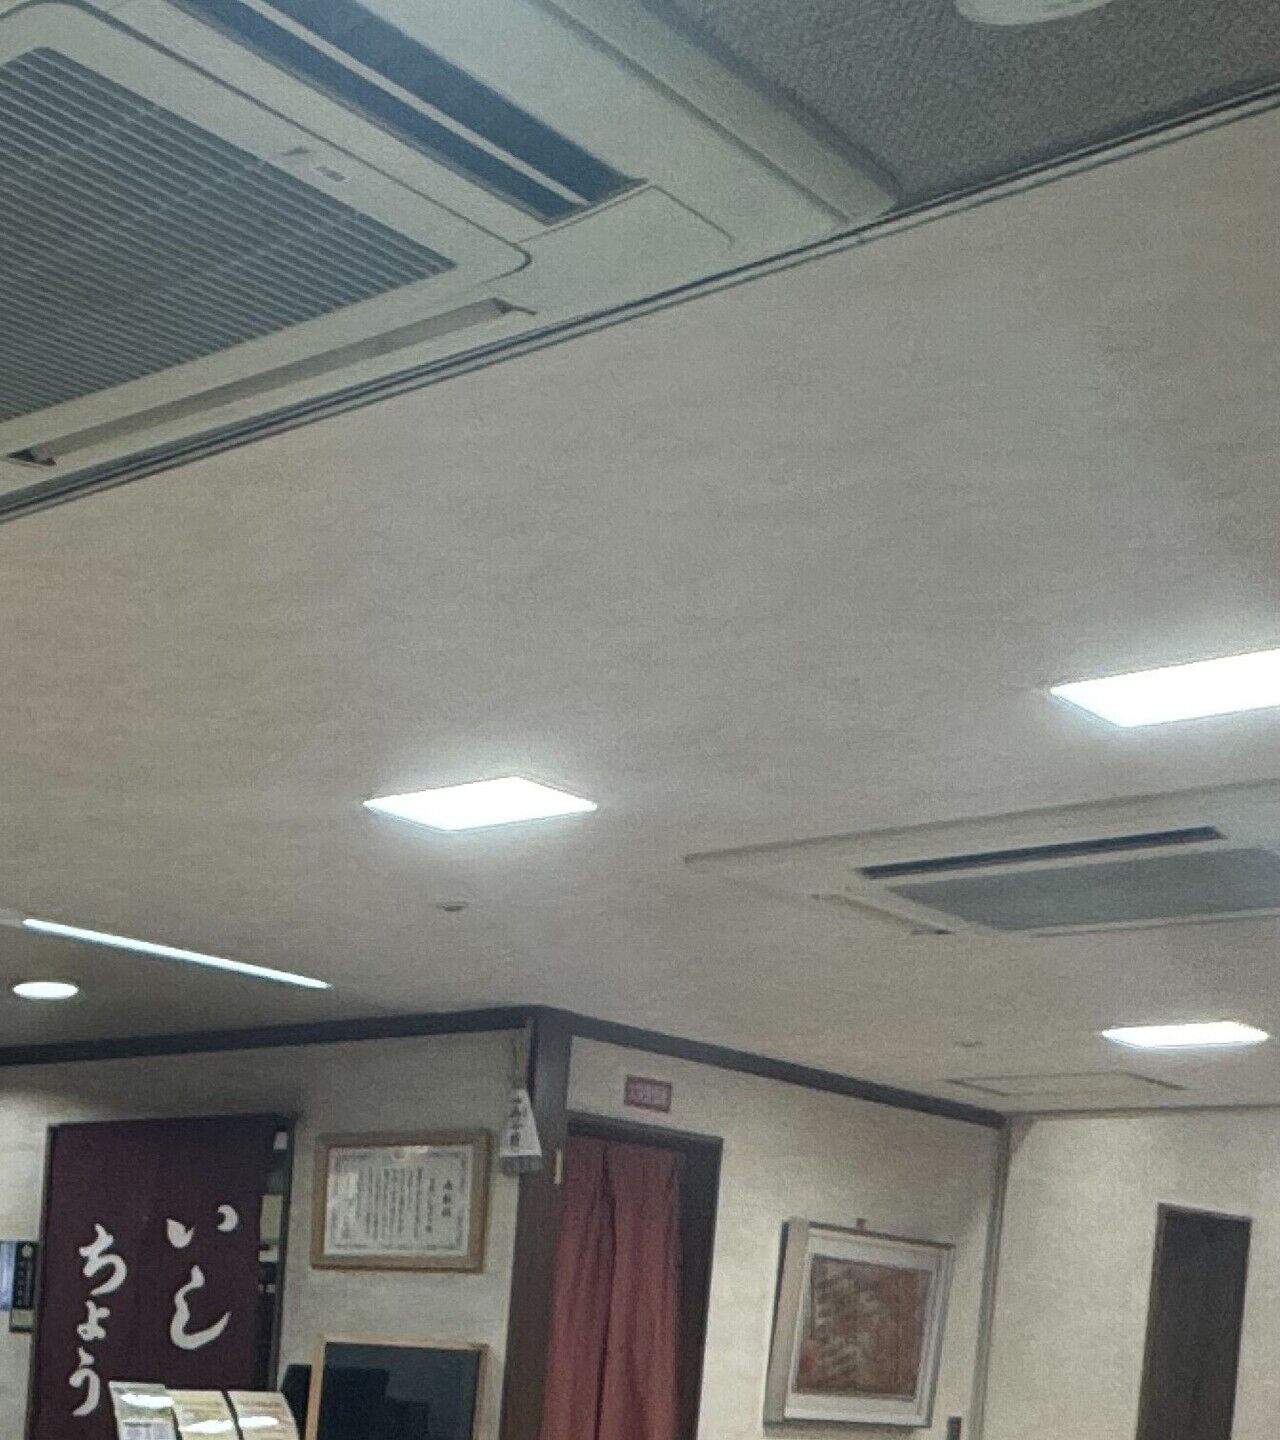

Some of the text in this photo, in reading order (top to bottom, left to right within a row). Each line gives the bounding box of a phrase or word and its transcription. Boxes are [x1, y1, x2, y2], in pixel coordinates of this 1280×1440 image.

[68, 1223, 128, 1417] ちょう
[166, 1204, 239, 1350] いし
